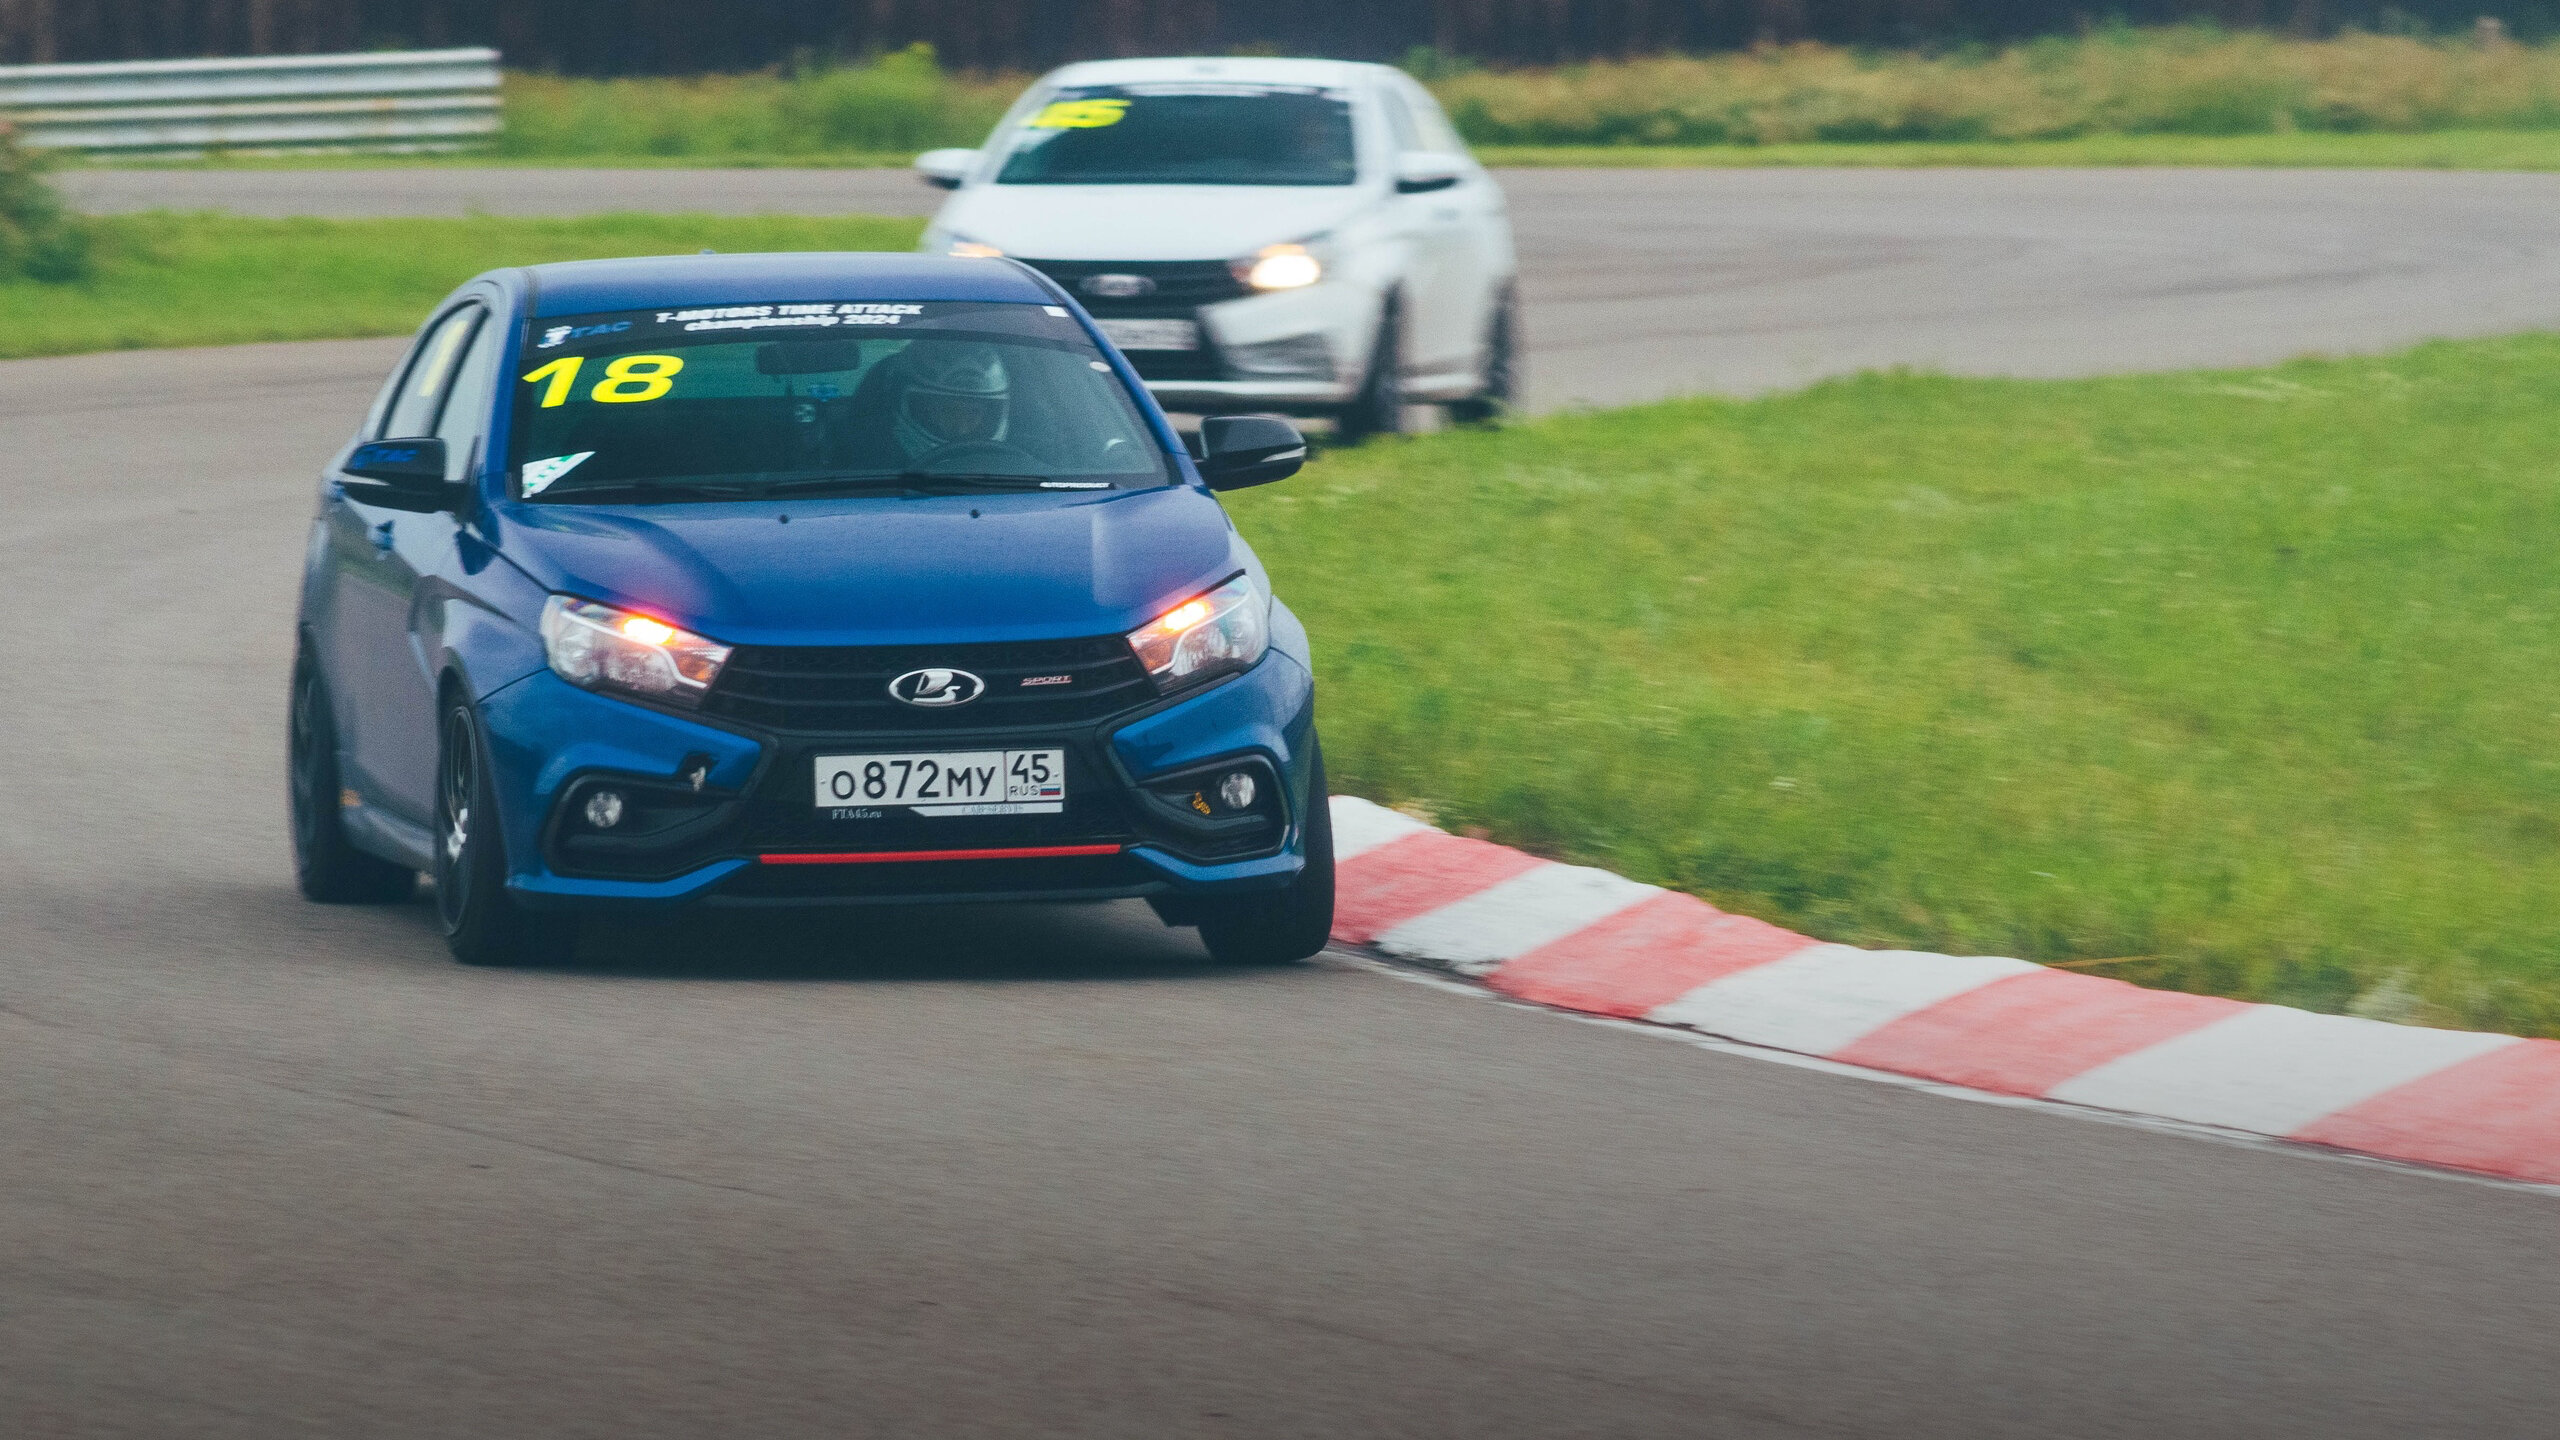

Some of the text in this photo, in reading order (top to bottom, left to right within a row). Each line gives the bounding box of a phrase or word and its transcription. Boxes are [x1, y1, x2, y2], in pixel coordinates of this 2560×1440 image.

[656, 304, 924, 323] T-MOTORS TIME ATTACK
[684, 314, 900, 331] championship 2024
[522, 354, 684, 408] 18
[1021, 675, 1072, 687] SPORT
[1011, 753, 1050, 784] 45
[1009, 784, 1039, 796] RUS
